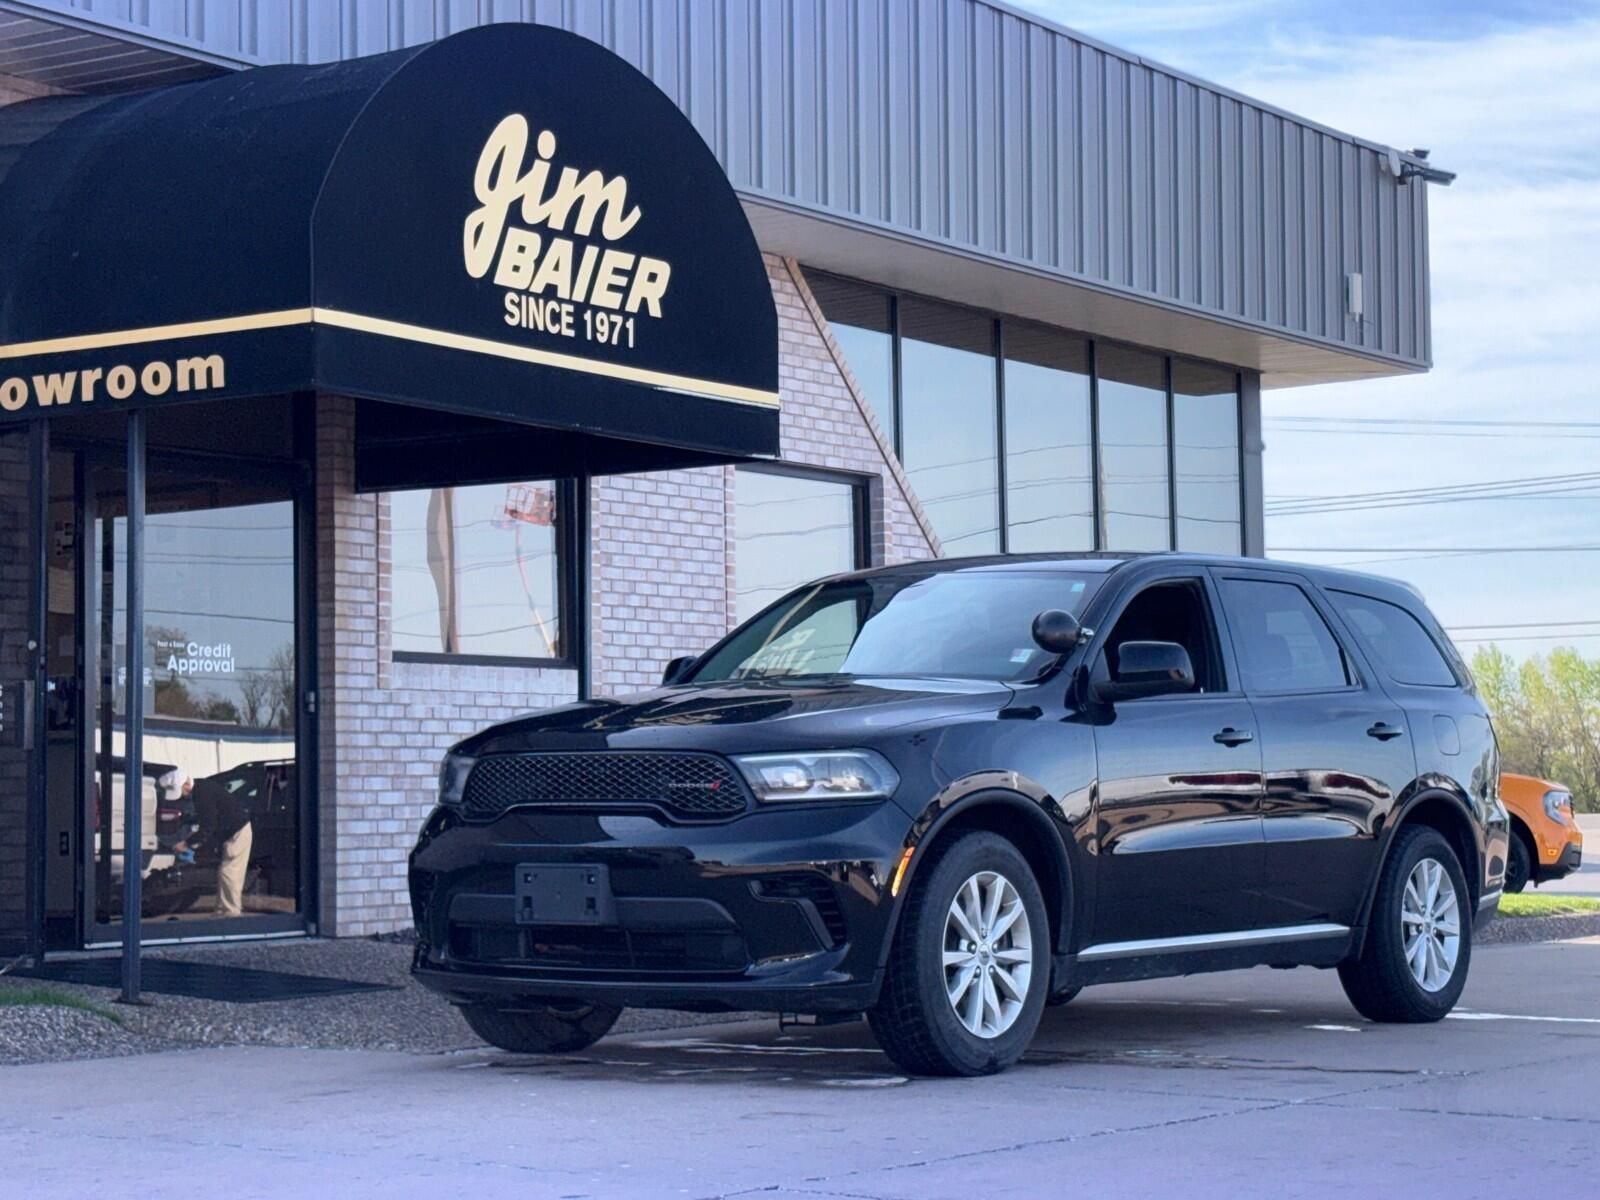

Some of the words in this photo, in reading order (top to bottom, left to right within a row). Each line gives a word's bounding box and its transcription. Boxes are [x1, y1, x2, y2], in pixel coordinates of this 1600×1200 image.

[464, 113, 642, 279] Jim
[493, 226, 672, 318] BAIER
[504, 291, 575, 337] SINCE
[583, 309, 635, 349] 1971
[0, 354, 225, 411] owroom
[167, 654, 235, 675] Approval
[187, 641, 232, 658] Credit
